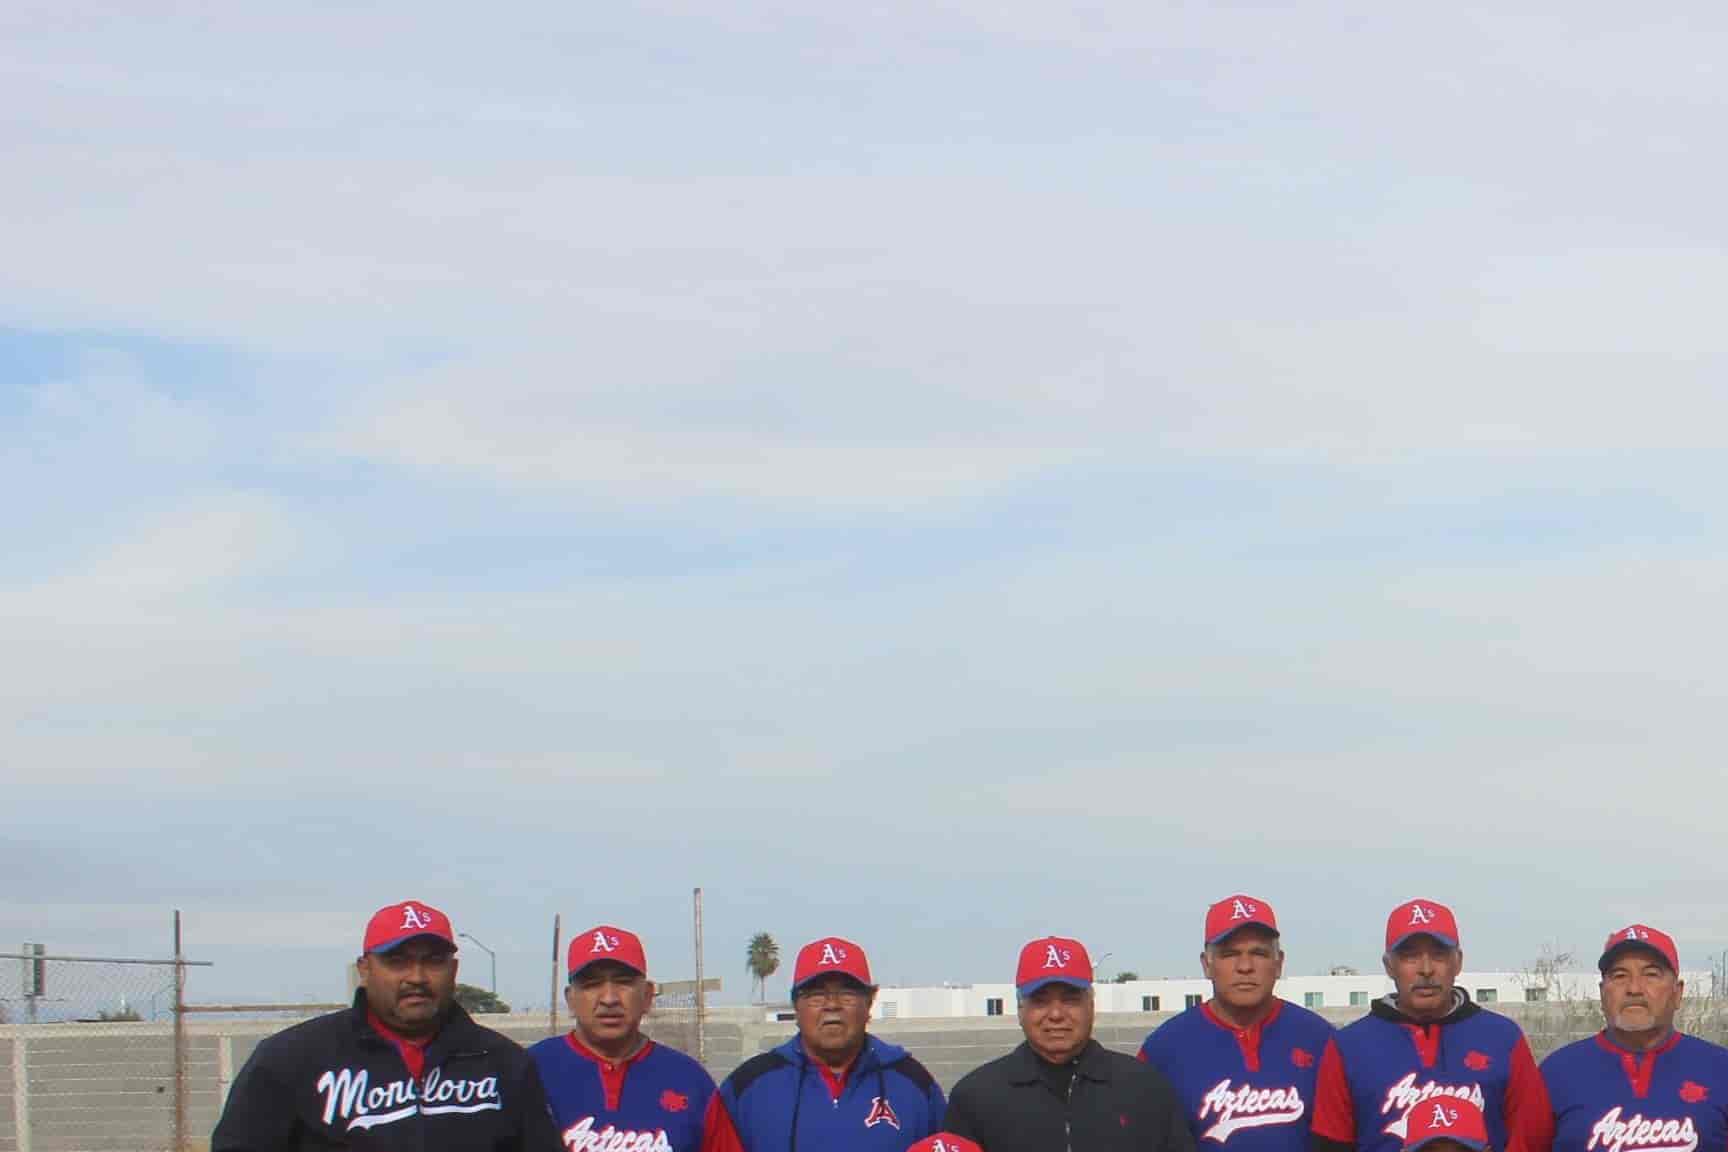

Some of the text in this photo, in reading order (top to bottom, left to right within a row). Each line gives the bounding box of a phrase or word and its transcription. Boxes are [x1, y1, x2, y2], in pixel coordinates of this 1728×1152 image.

[400, 906, 431, 928] A's
[1231, 900, 1257, 920] A's
[1408, 905, 1436, 925] A's
[590, 931, 620, 952] A's
[818, 944, 847, 964] A's
[1042, 945, 1071, 968] A's
[1198, 1078, 1305, 1143] Aztecas
[1427, 1104, 1458, 1128] A's
